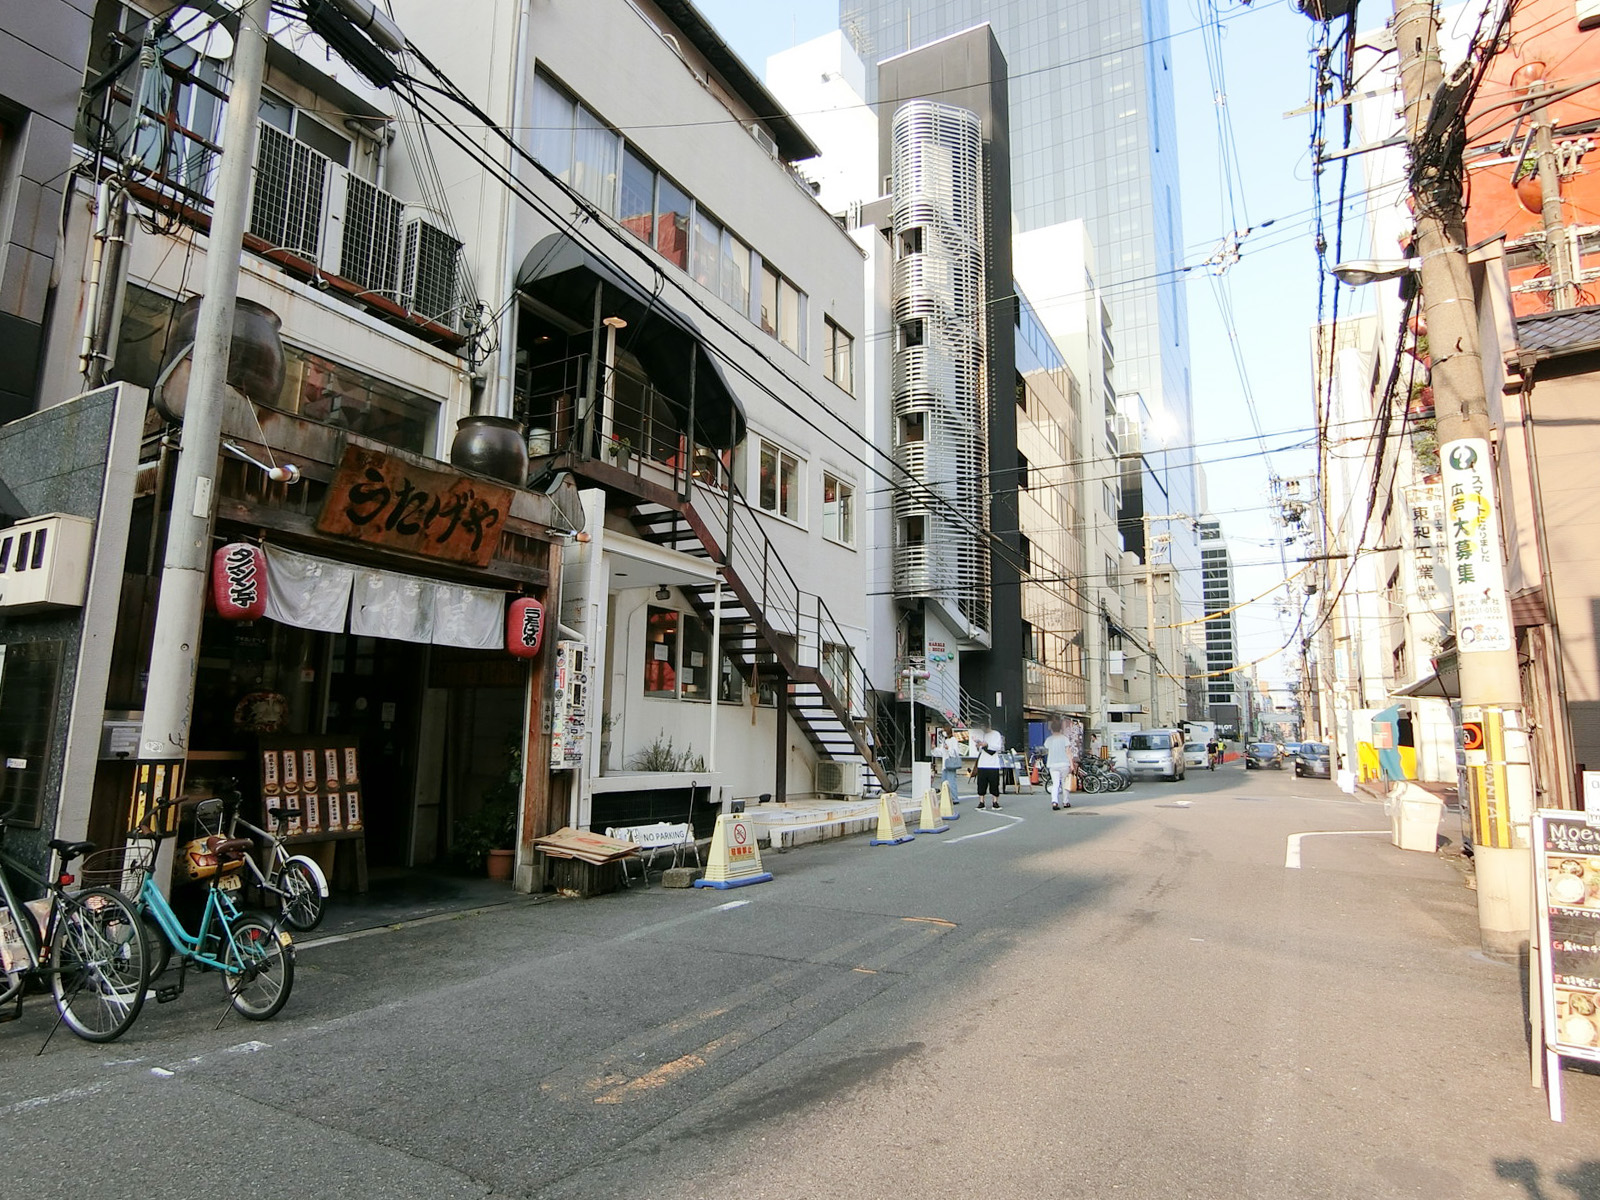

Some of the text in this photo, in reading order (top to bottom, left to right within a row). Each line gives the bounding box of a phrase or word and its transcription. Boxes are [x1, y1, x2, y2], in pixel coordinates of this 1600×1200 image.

[347, 467, 499, 551] うたげや
[1412, 506, 1433, 580] 東和工業
[1450, 483, 1476, 585] 広告大募集
[1471, 475, 1491, 563] スマートになりました
[522, 607, 541, 647] うたげや
[643, 832, 655, 842] NO
[655, 829, 685, 841] PARKING
